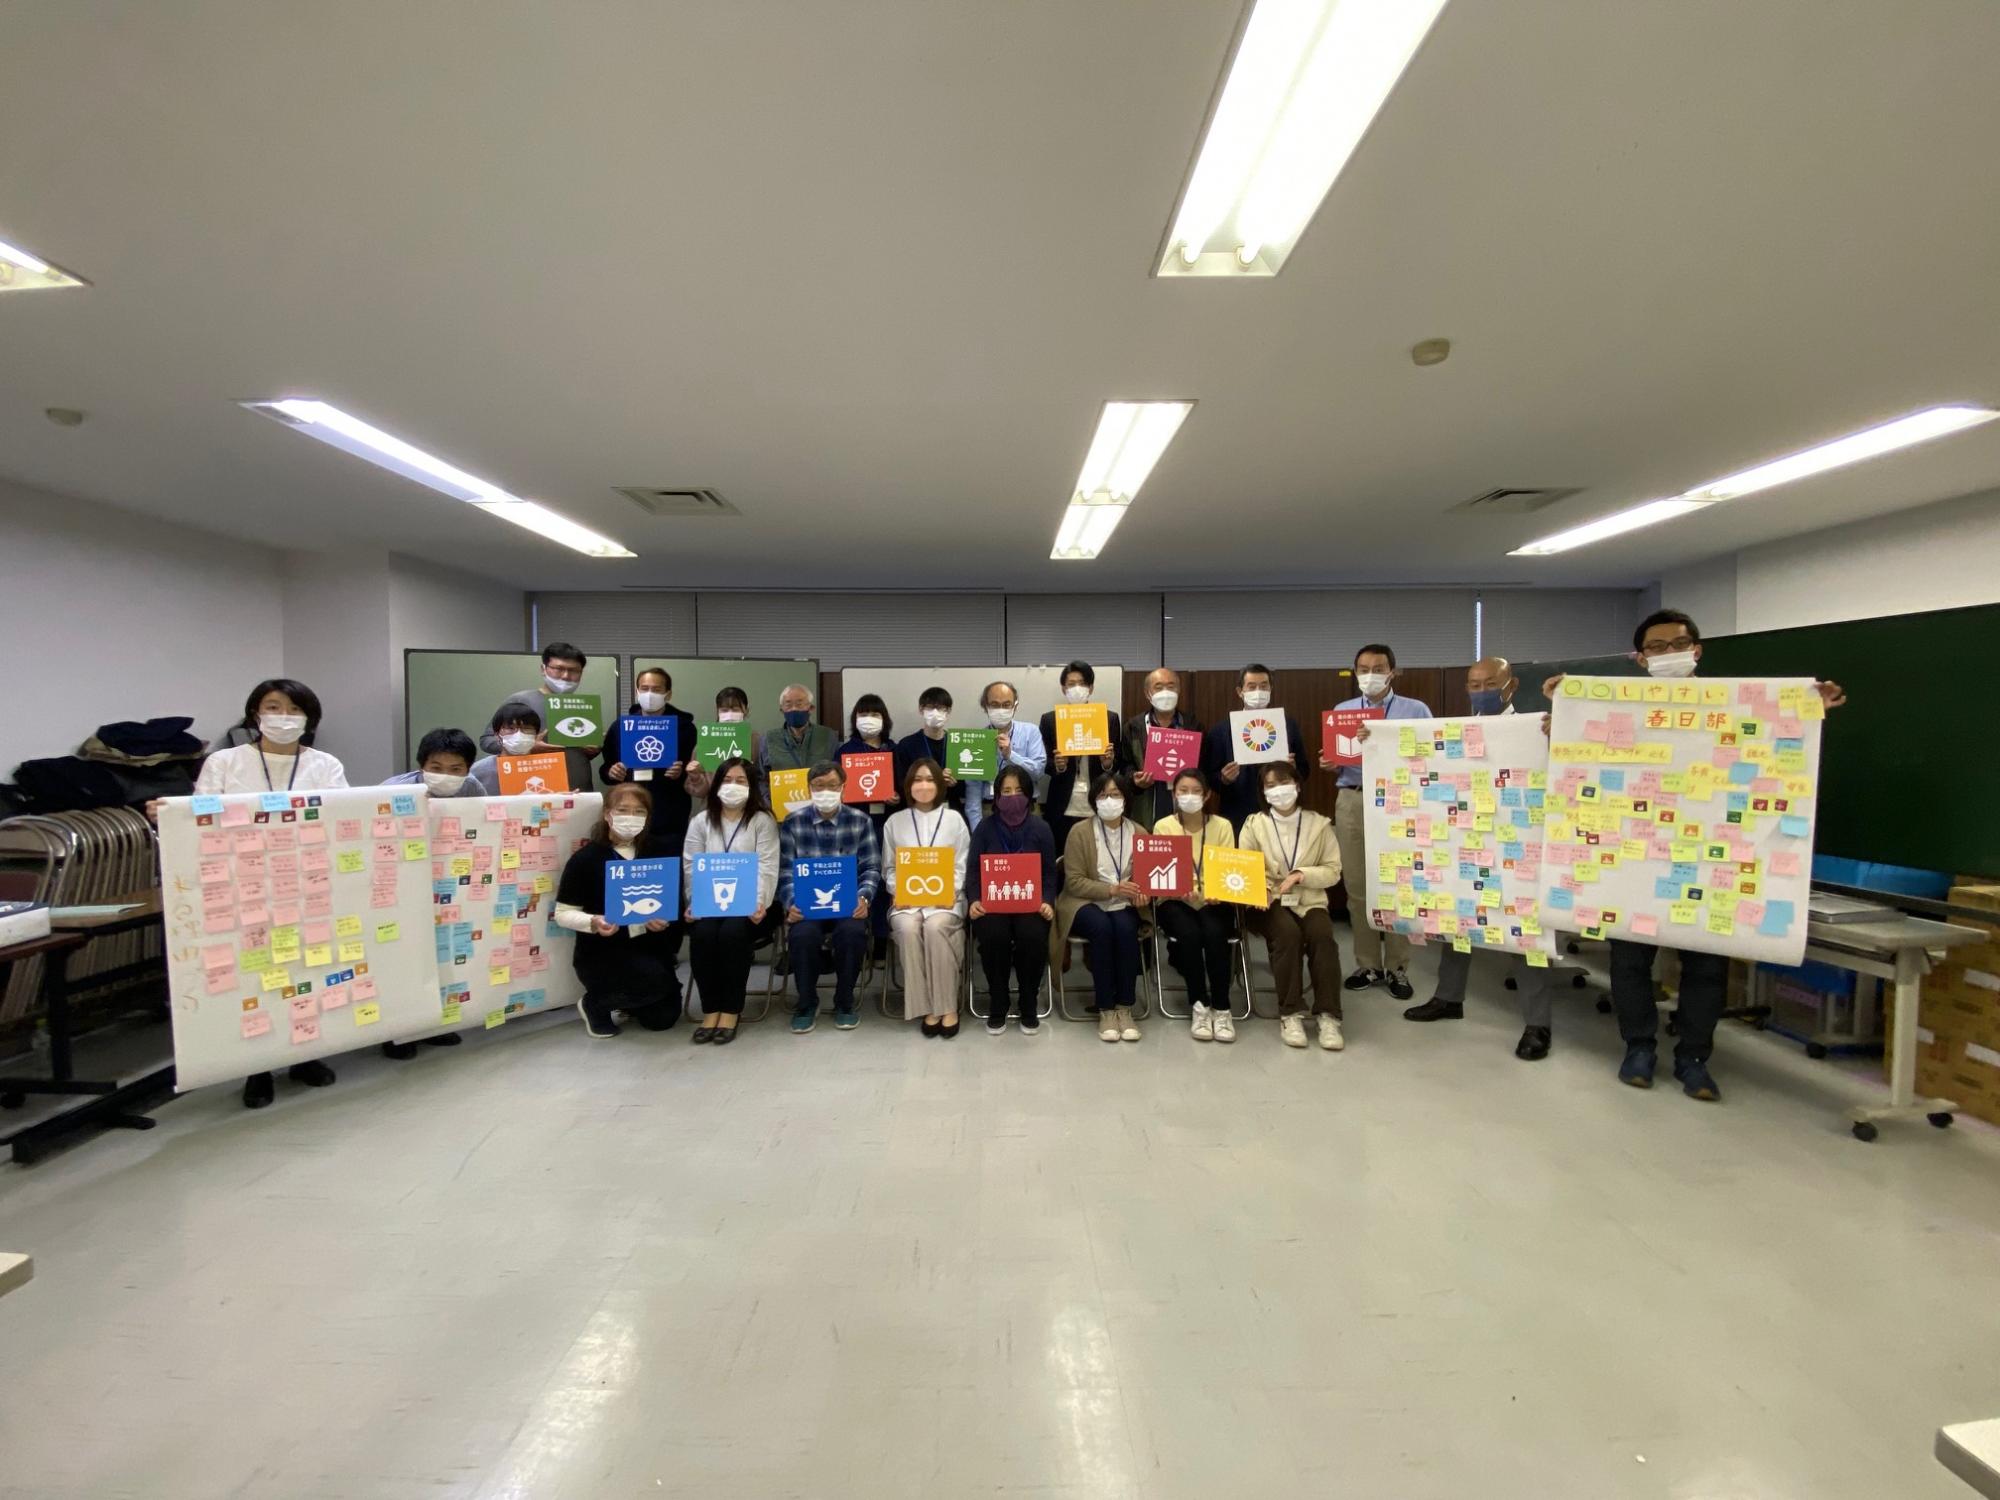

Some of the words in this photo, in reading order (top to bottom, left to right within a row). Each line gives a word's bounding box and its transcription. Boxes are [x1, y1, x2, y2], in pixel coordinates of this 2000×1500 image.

[548, 697, 560, 709] 13
[1059, 708, 1067, 720] 11
[1648, 708, 1727, 730] 春日部
[624, 719, 634, 731] 17
[1327, 714, 1334, 727] 4
[701, 725, 708, 736] 3
[950, 732, 960, 743] 15
[1151, 731, 1162, 743] 10
[502, 761, 512, 774] 9
[845, 757, 852, 768] 5
[774, 775, 781, 786] 2
[1137, 839, 1145, 852] 8
[899, 851, 911, 865] 12
[1208, 849, 1215, 860] 7
[697, 858, 706, 871] 6
[796, 863, 810, 877] 16
[983, 859, 990, 871] 1
[609, 865, 625, 880] 14
